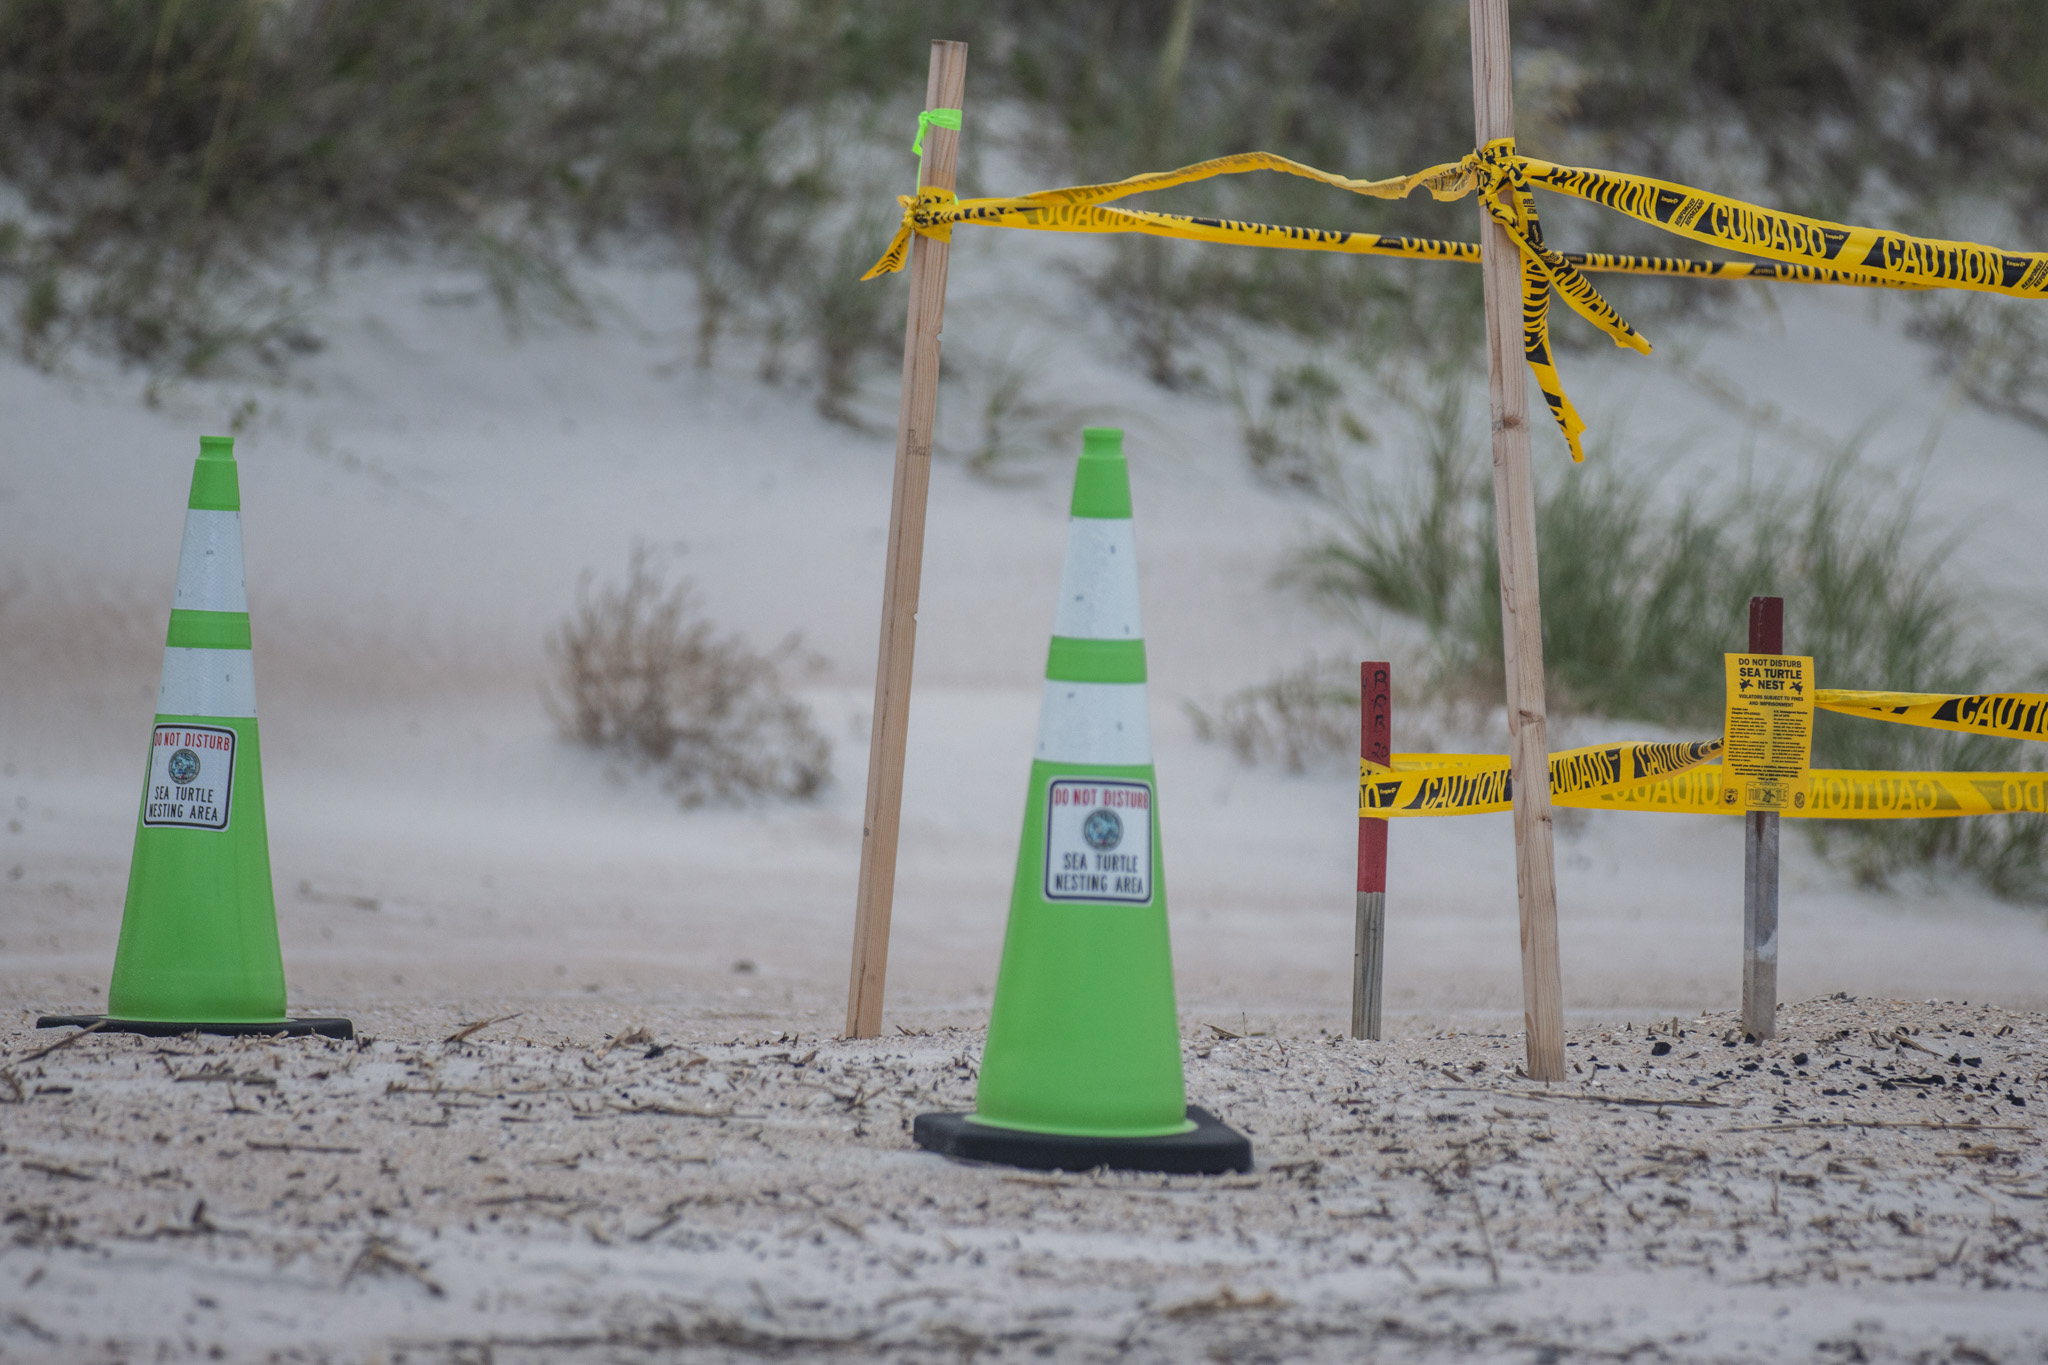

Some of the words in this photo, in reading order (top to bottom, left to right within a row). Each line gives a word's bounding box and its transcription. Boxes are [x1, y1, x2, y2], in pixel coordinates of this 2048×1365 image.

[1547, 167, 1659, 222] CAUTION
[1711, 203, 1827, 259] CUIDADO
[1884, 237, 2004, 288] CAUTION
[1740, 667, 1761, 677] SEA
[1764, 669, 1802, 680] TURTLE
[1770, 660, 1802, 668] DISTURB
[1758, 680, 1785, 690] NEST
[154, 733, 162, 746] DO
[164, 732, 180, 747] NOT
[184, 733, 230, 751] DISTURB
[154, 785, 169, 801] SEA
[175, 786, 214, 804] TURTLE
[1055, 788, 1069, 806] DO
[1073, 788, 1097, 806] NOT
[1103, 790, 1149, 810] DISTURB
[1421, 768, 1508, 809] CAUTION
[149, 803, 184, 818] NESTING
[189, 804, 218, 822] AREA
[1064, 852, 1088, 871] SEA
[1096, 854, 1138, 874] TURTLE
[1055, 873, 1108, 892] NESTING
[1115, 876, 1144, 894] AREA
